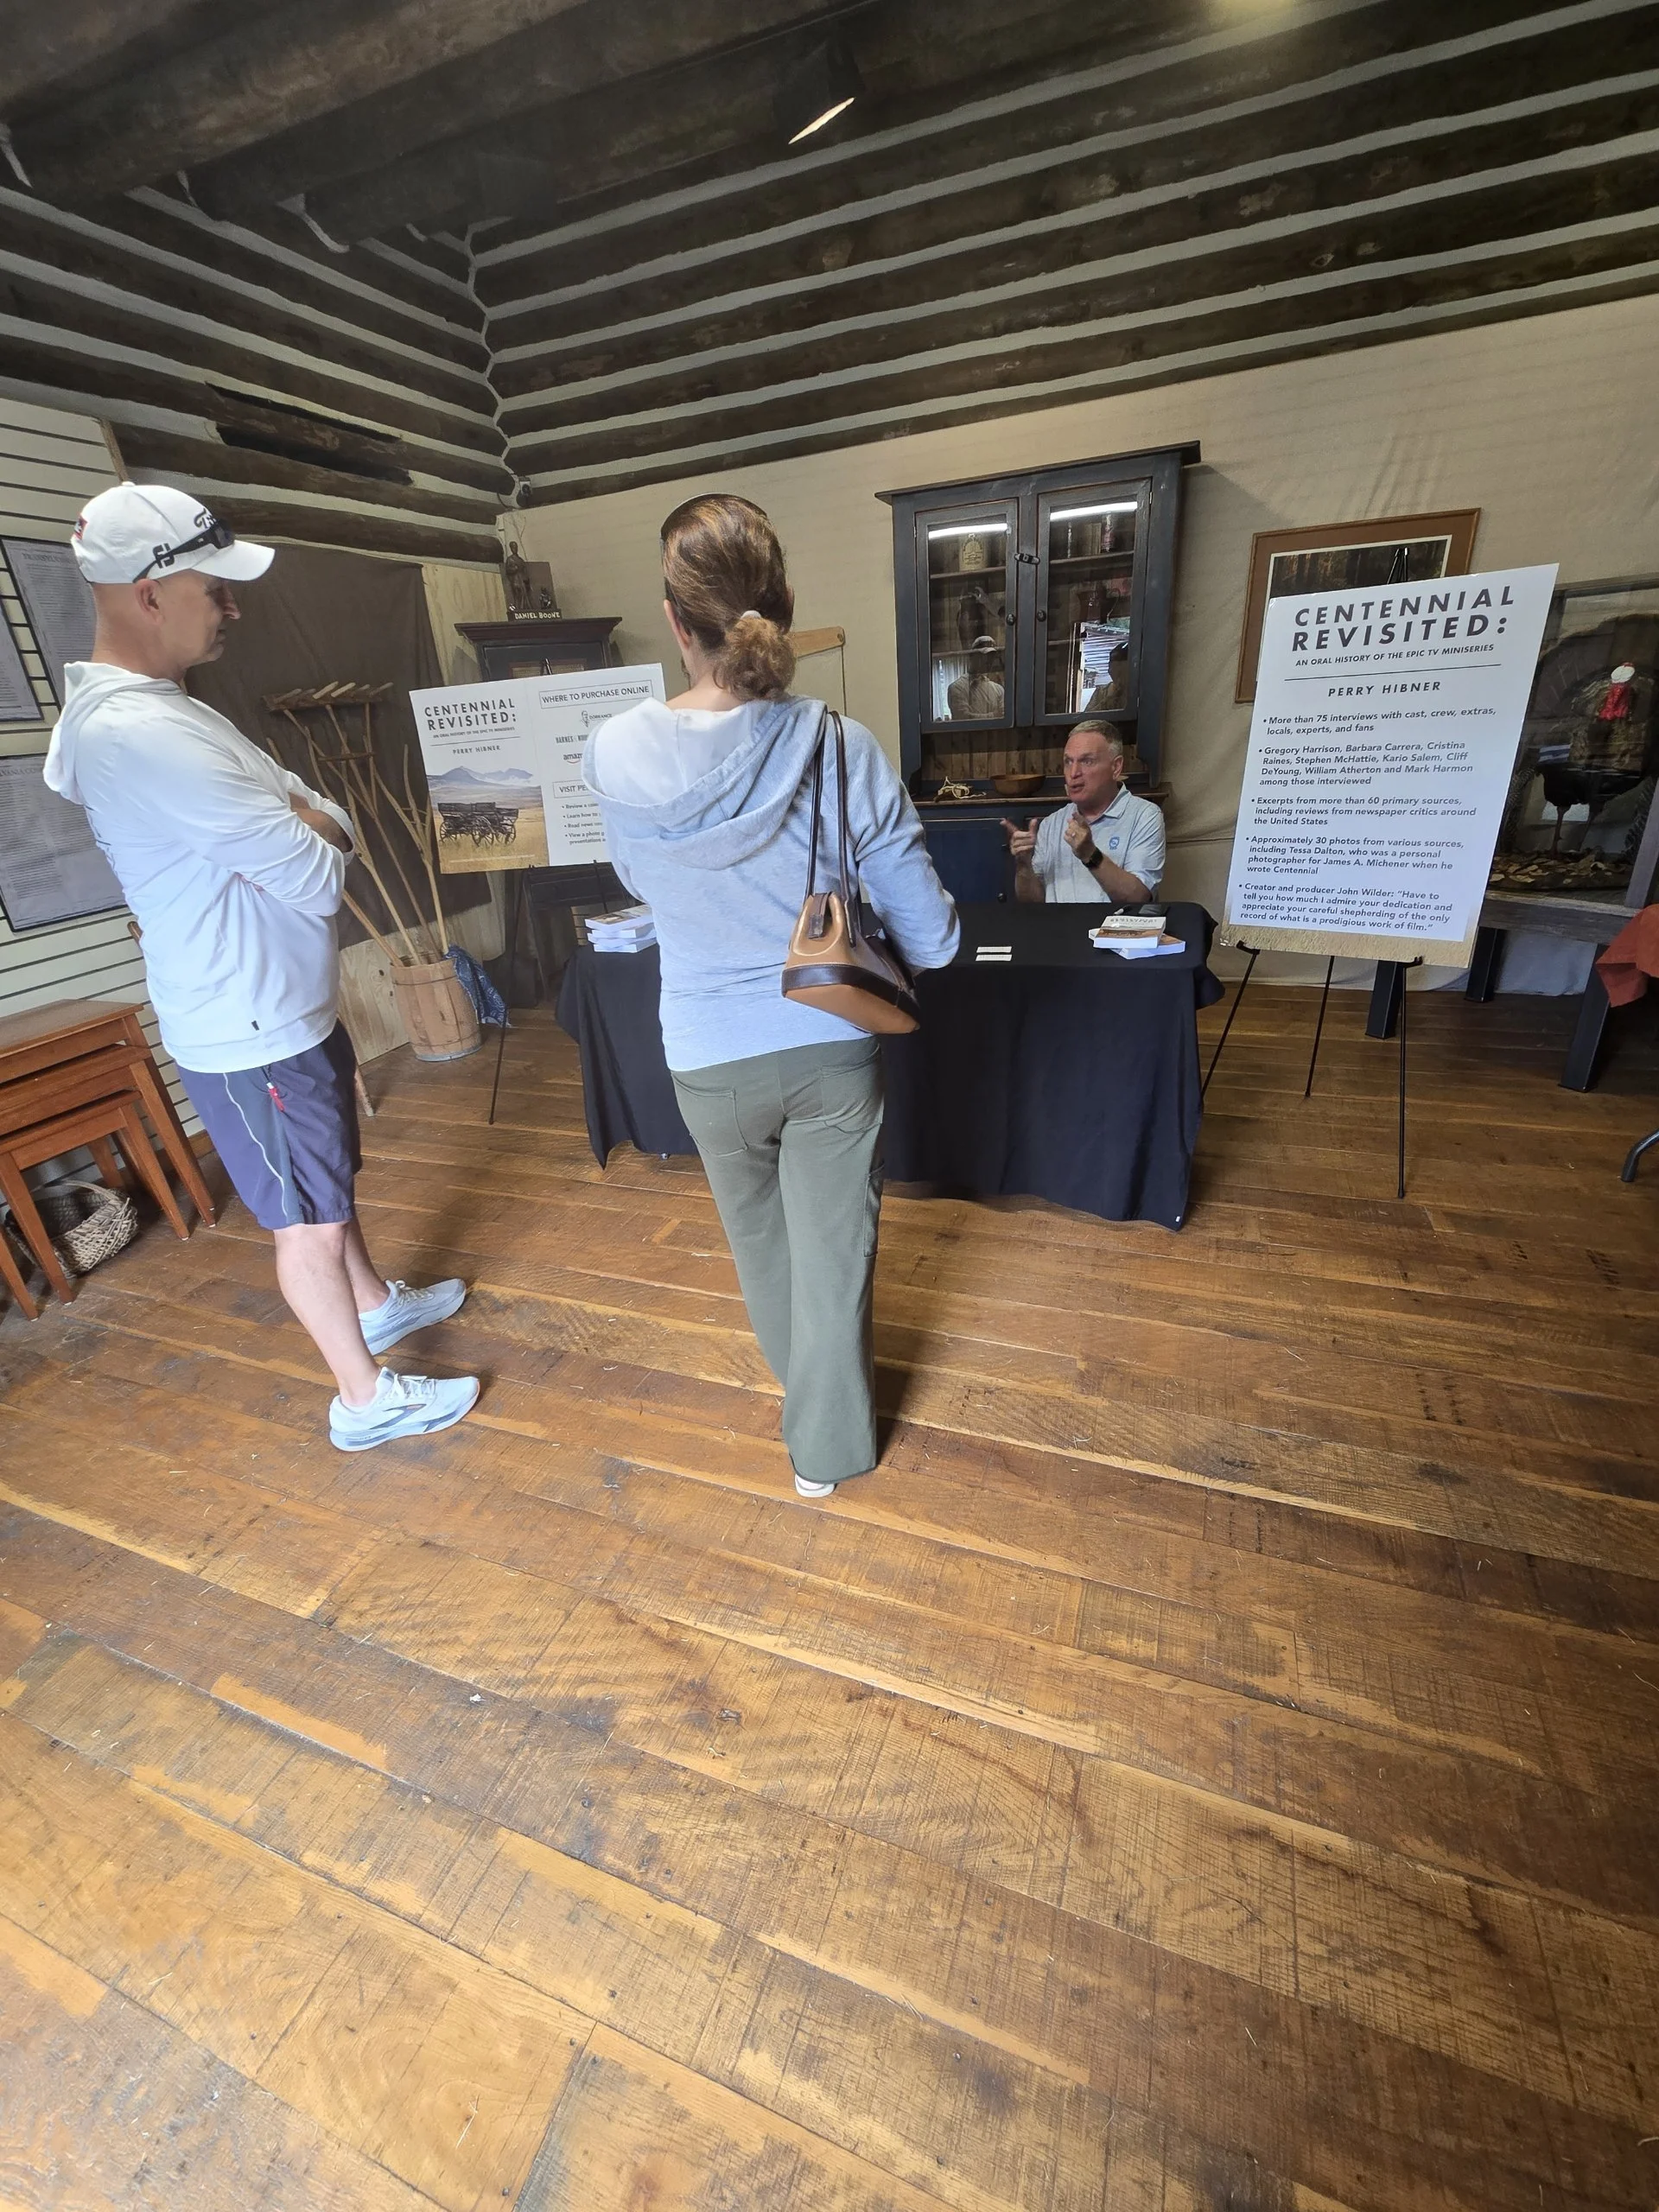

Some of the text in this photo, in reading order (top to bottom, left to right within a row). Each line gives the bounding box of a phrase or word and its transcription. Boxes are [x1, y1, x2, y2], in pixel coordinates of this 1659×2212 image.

[1294, 585, 1514, 626] CENTENNIAL
[1292, 613, 1508, 652] REVISITED:
[1335, 654, 1370, 663] HISTORY
[1441, 644, 1494, 655] MINISERIES
[542, 694, 569, 703] WHERE
[581, 689, 620, 700] PURCHASE
[621, 685, 649, 696] ONLINE
[1328, 682, 1440, 696] PERRY HIBNER
[424, 698, 515, 716] CENTENNIAL
[428, 711, 516, 730] REVISITED:
[1330, 713, 1377, 721] interviews
[1381, 710, 1402, 719] with
[1267, 727, 1293, 735] locals,
[1296, 726, 1332, 735] experts,
[1295, 756, 1332, 766] Stephen
[1334, 754, 1379, 763] McHattie,
[1446, 752, 1468, 760] Cliff
[1262, 767, 1301, 776] DeYoung,
[1318, 776, 1371, 785] interviewed
[1382, 797, 1419, 806] primary
[1255, 807, 1293, 817] including
[1251, 836, 1313, 845] Approximately
[1329, 836, 1360, 846] photos
[1249, 845, 1287, 855] including
[1314, 847, 1345, 855] Dalton,
[1248, 855, 1306, 865] photographer
[1366, 859, 1409, 868] Michener
[1274, 866, 1319, 874] Centennial
[1362, 888, 1394, 897] Wilder:
[1382, 899, 1431, 910] dedication
[1340, 907, 1395, 919] shepherding
[1429, 914, 1450, 924] only
[1319, 918, 1365, 926] prodigious
